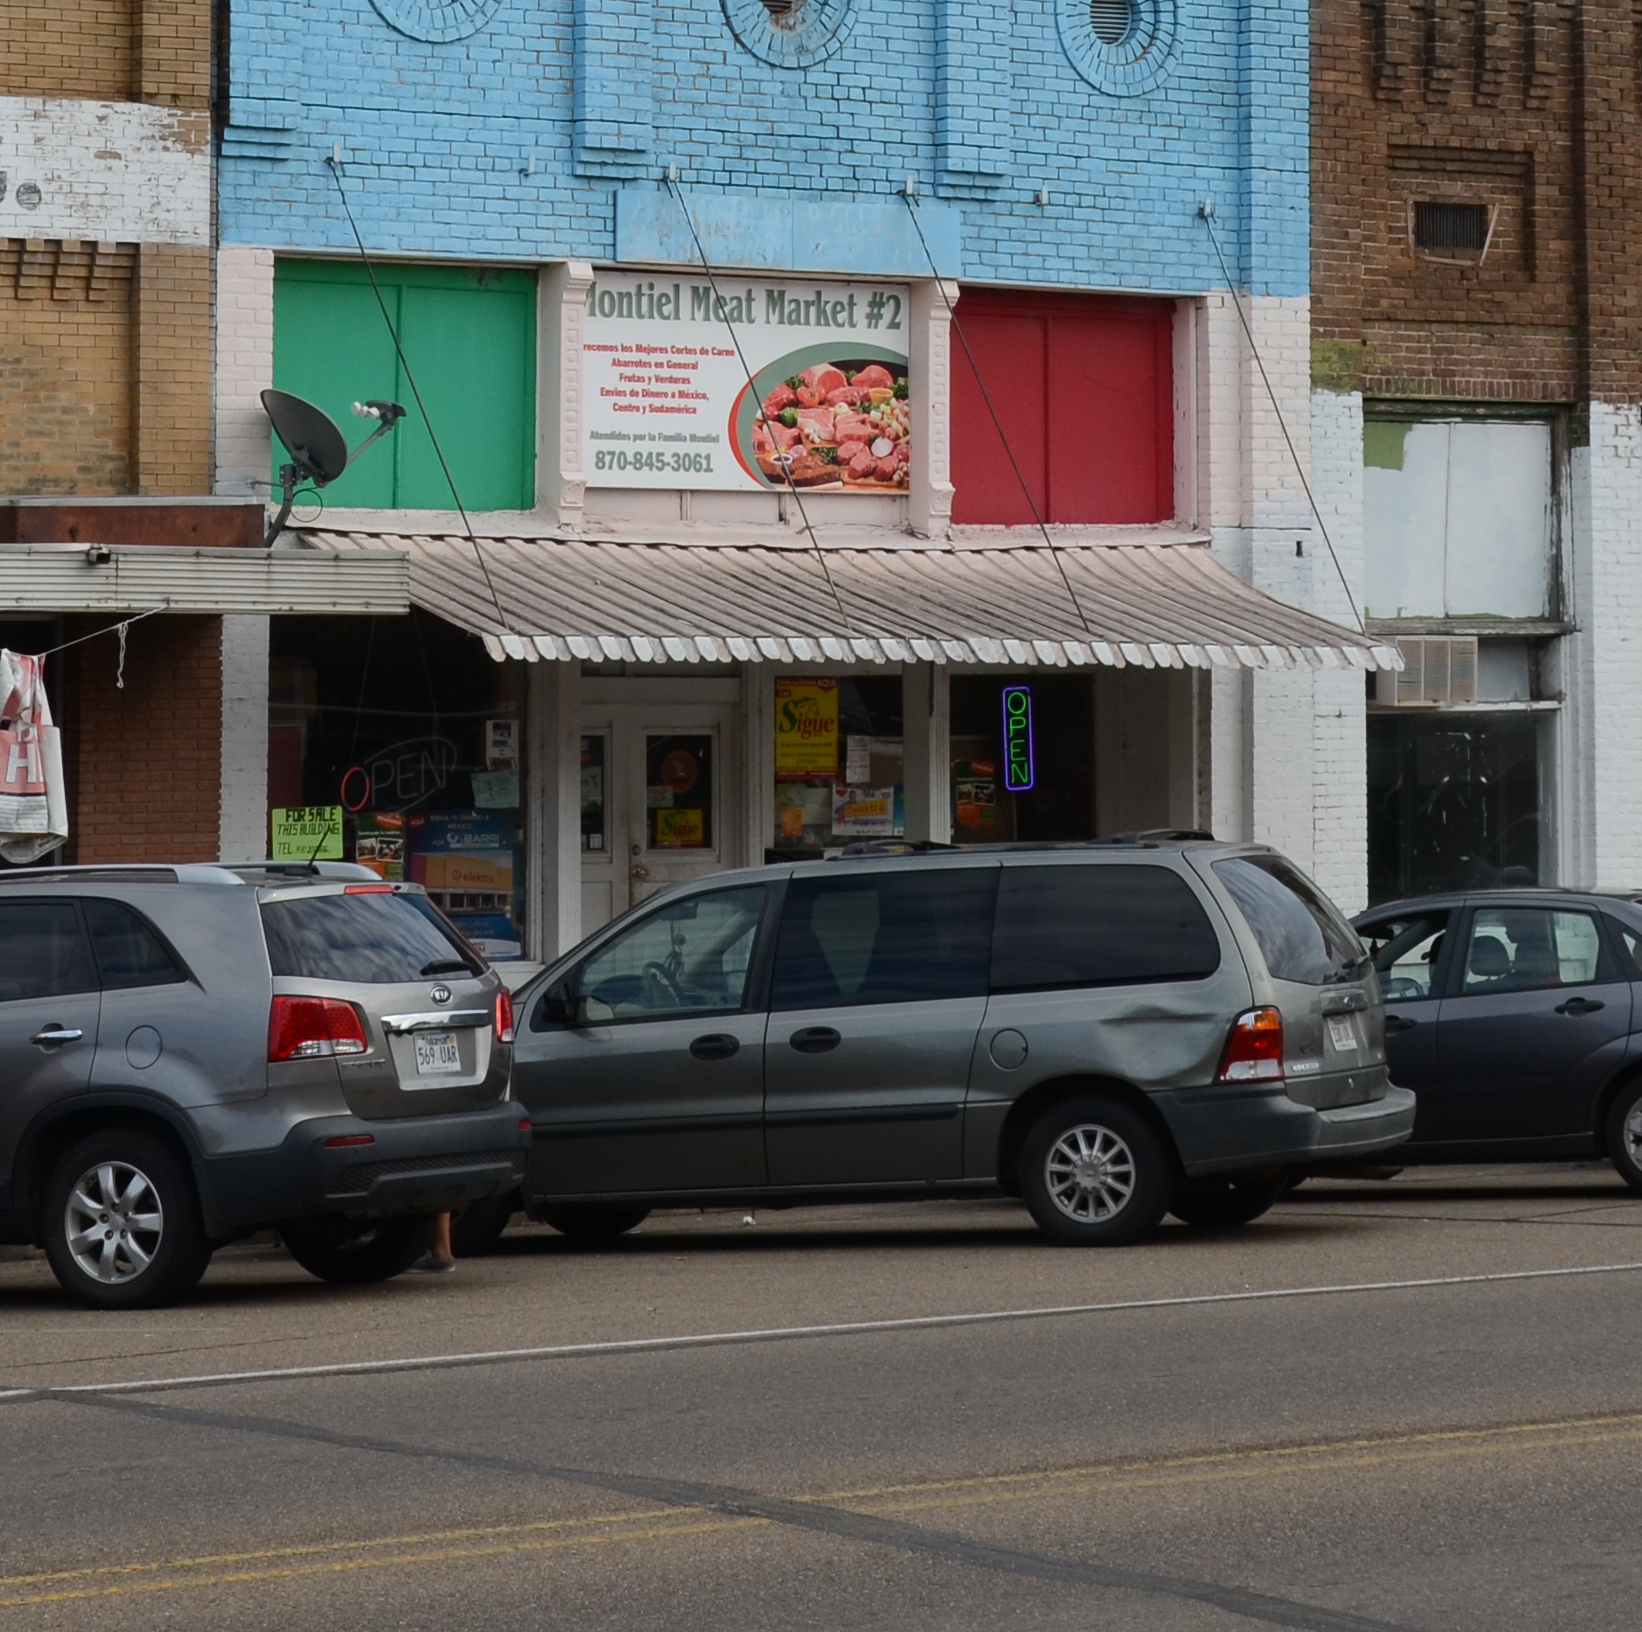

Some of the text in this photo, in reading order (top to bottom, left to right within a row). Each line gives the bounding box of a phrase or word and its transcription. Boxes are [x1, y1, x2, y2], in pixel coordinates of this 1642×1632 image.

[690, 286, 756, 324] Meat
[764, 288, 857, 329] Market
[865, 290, 902, 331] #2
[621, 343, 633, 353] los
[635, 343, 668, 356] Mejores
[671, 345, 697, 356] Cortes
[699, 346, 708, 356] de
[711, 347, 735, 357] Carne
[611, 358, 699, 370] Abarrotes en General
[619, 372, 691, 385] Frutas y Verduras
[629, 388, 639, 398] de
[641, 388, 668, 399] Dinero
[613, 402, 640, 413] Centro
[642, 405, 647, 415] y
[632, 433, 646, 443] por
[648, 432, 656, 441] la
[595, 450, 714, 473] 870-845-3061
[778, 699, 834, 740] Sigue
[1007, 691, 1029, 784] OPEN
[340, 746, 447, 813] OPEN
[286, 807, 337, 822] FOR SALE
[277, 823, 299, 836] THIS
[464, 834, 499, 843] BARRI
[463, 872, 494, 883] elektra
[418, 1046, 435, 1065] 569
